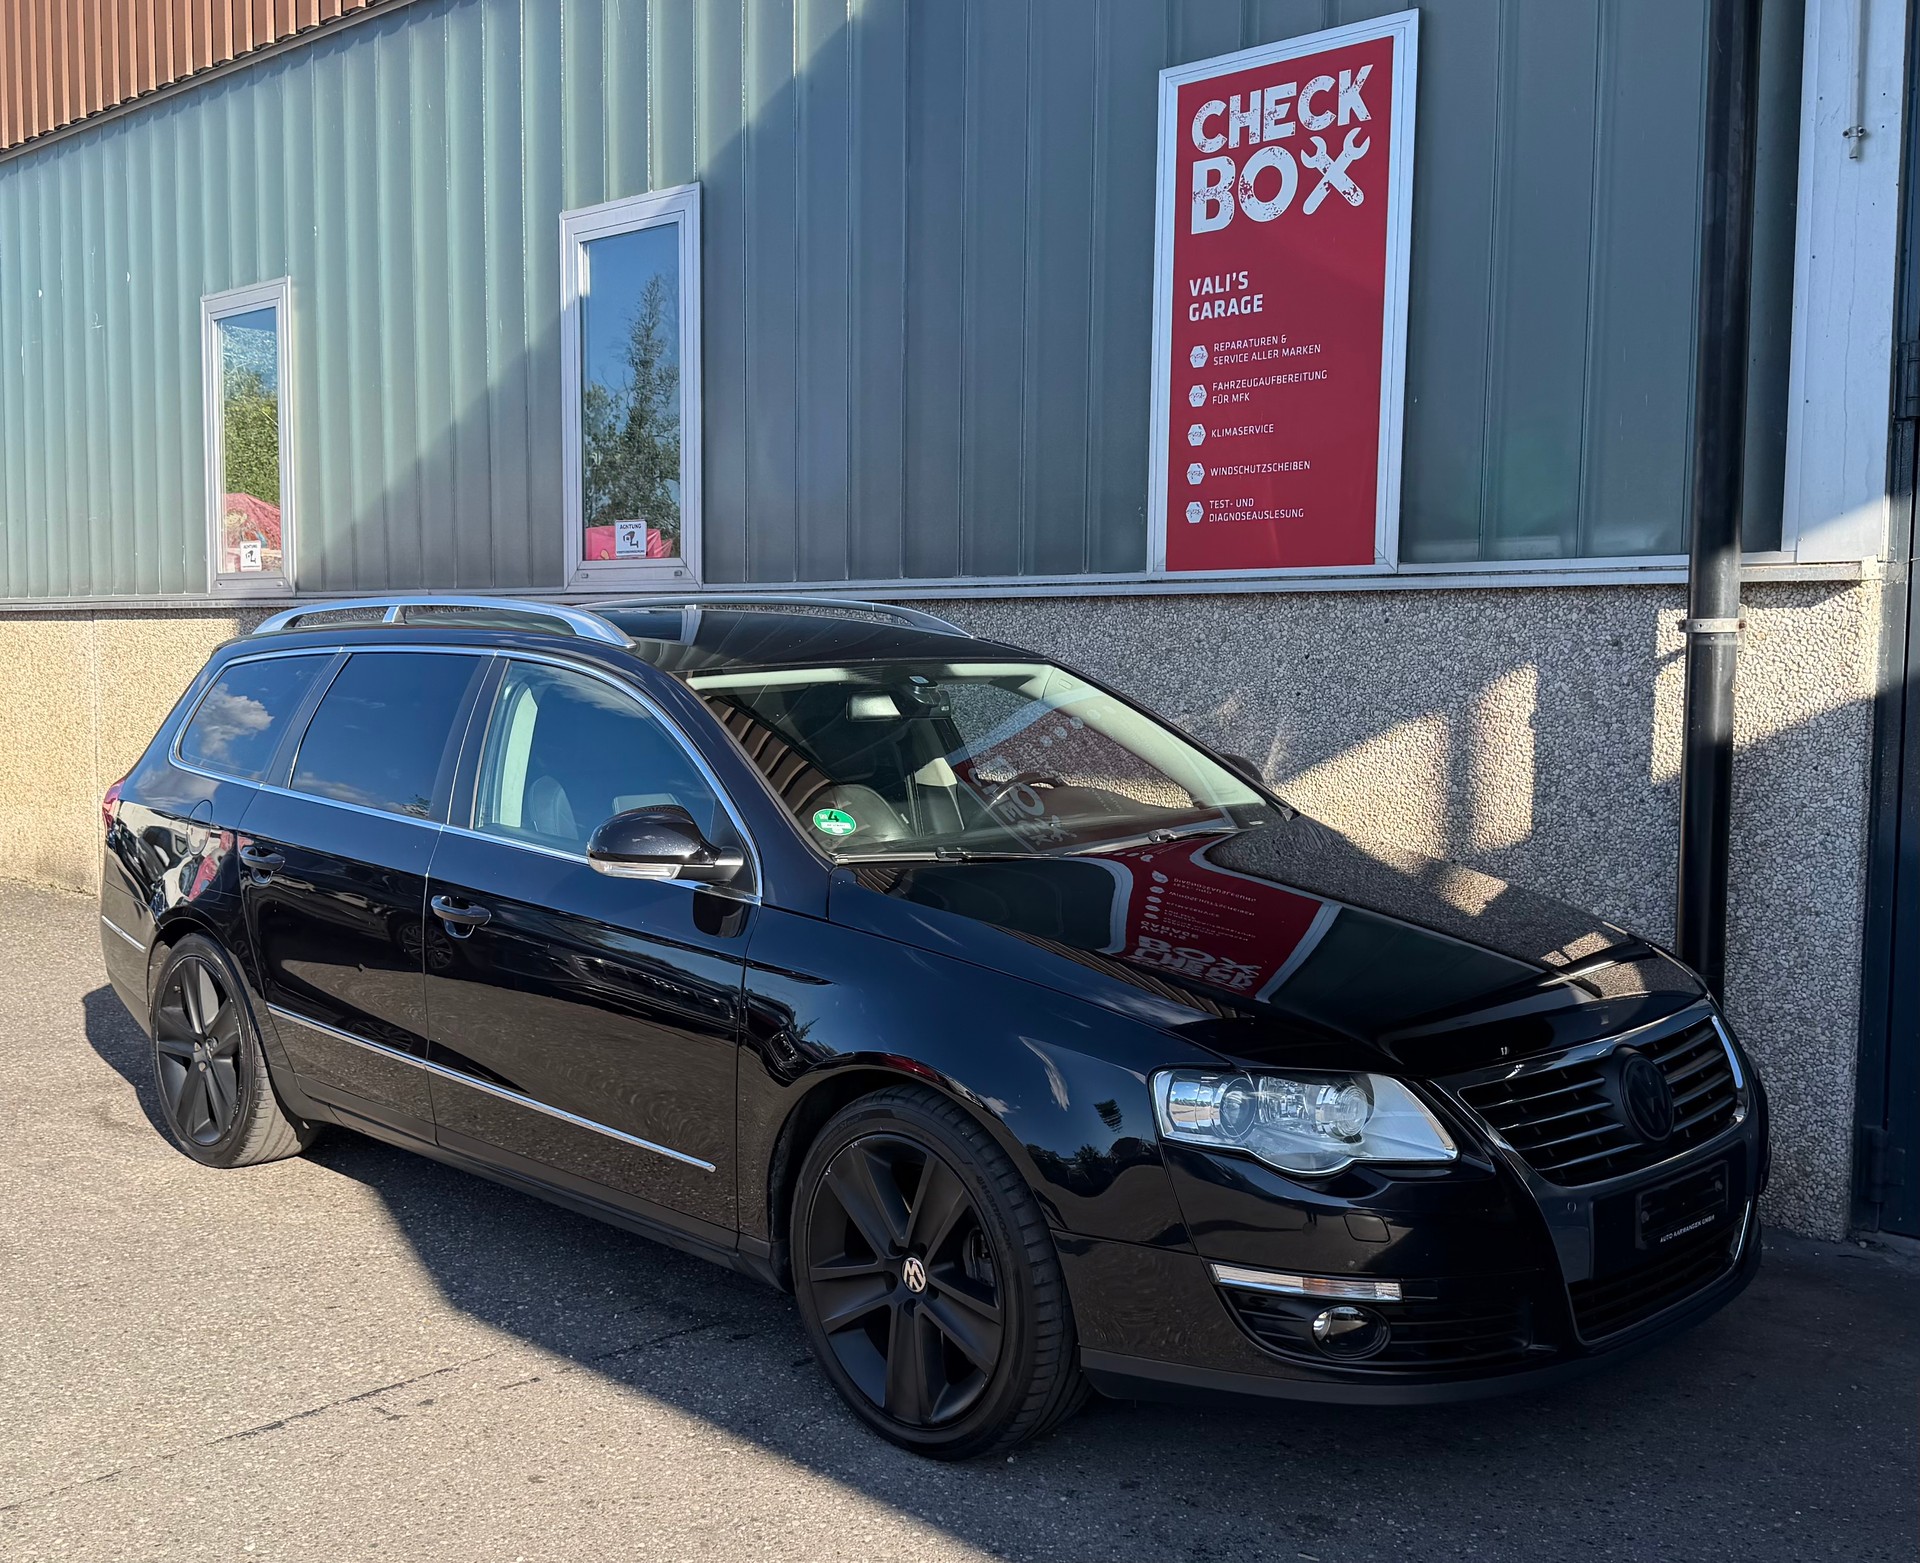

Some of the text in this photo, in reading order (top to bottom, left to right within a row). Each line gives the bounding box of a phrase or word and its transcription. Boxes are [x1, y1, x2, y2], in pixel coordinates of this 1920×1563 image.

[1191, 64, 1374, 153] CHECK
[1191, 127, 1371, 235] BOX
[1189, 271, 1248, 296] VALI'S
[1189, 294, 1263, 321] GARAGE
[1214, 335, 1287, 352] REPARATUREN &
[1214, 344, 1321, 366] SERVICE ALLER MARKEN
[1212, 370, 1328, 391] FAHRZEUGAUFBEREITUNG
[1212, 393, 1250, 405] FÜR MFK
[1211, 424, 1274, 438] KLIMASERVICE
[1210, 461, 1311, 476] WINDSCHUTZSCHEIBEN
[1209, 498, 1254, 509] TEST- UND
[1209, 508, 1304, 523] DIAGNOSEAUSLESUNG
[828, 811, 839, 822] 4
[1660, 1233, 1673, 1242] AUTO
